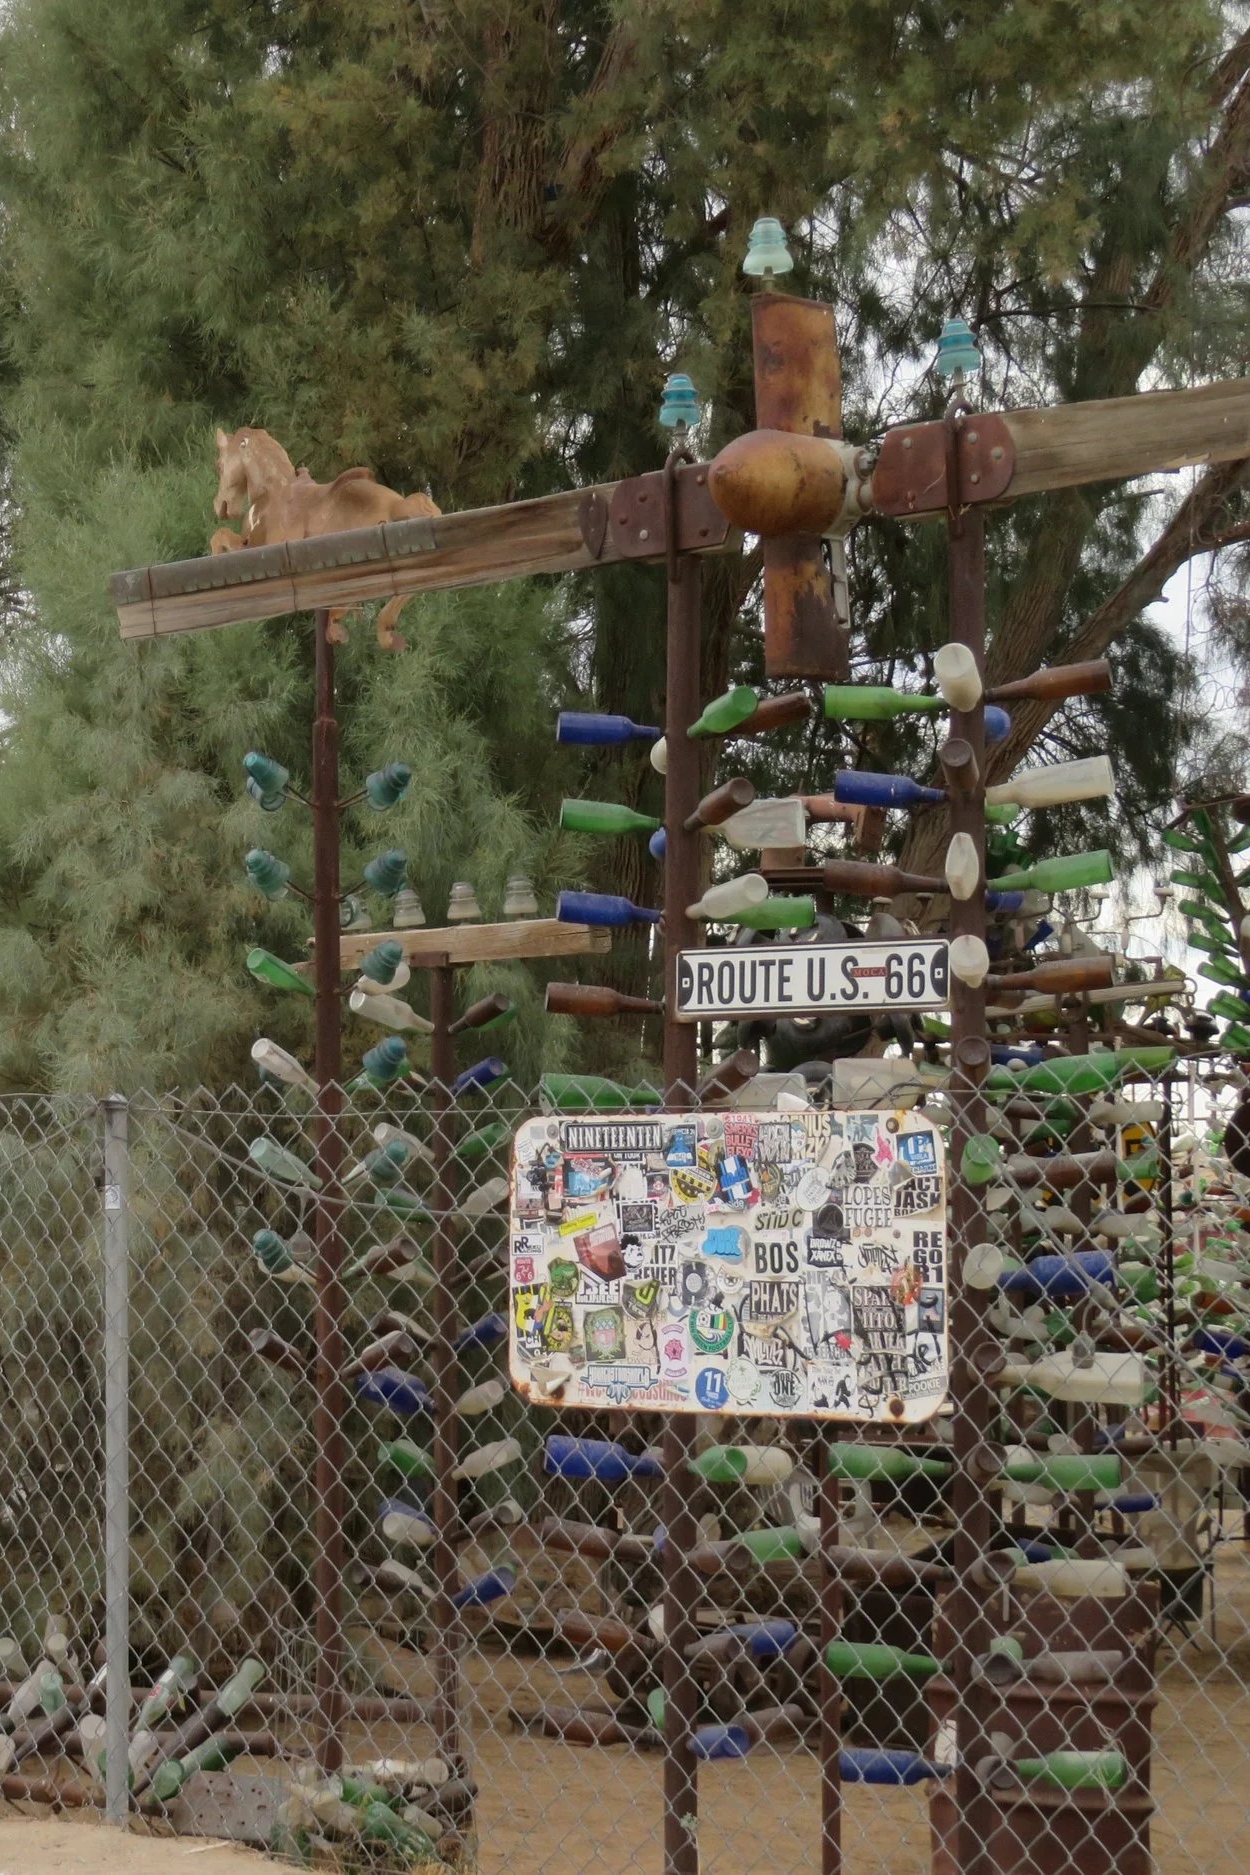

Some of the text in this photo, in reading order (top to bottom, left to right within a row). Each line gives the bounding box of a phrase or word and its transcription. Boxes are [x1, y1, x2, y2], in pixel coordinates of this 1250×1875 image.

[697, 952, 926, 1005] ROUTE U.S. 66
[568, 1126, 661, 1149] NINETEENTEN
[844, 1186, 892, 1206] LOPES
[845, 1207, 892, 1228] FUGEE
[913, 1231, 942, 1248] RE
[913, 1249, 943, 1265] GO
[751, 1281, 799, 1314] PHATS
[704, 1371, 722, 1393] 11
[908, 1376, 942, 1394] POOKIE
